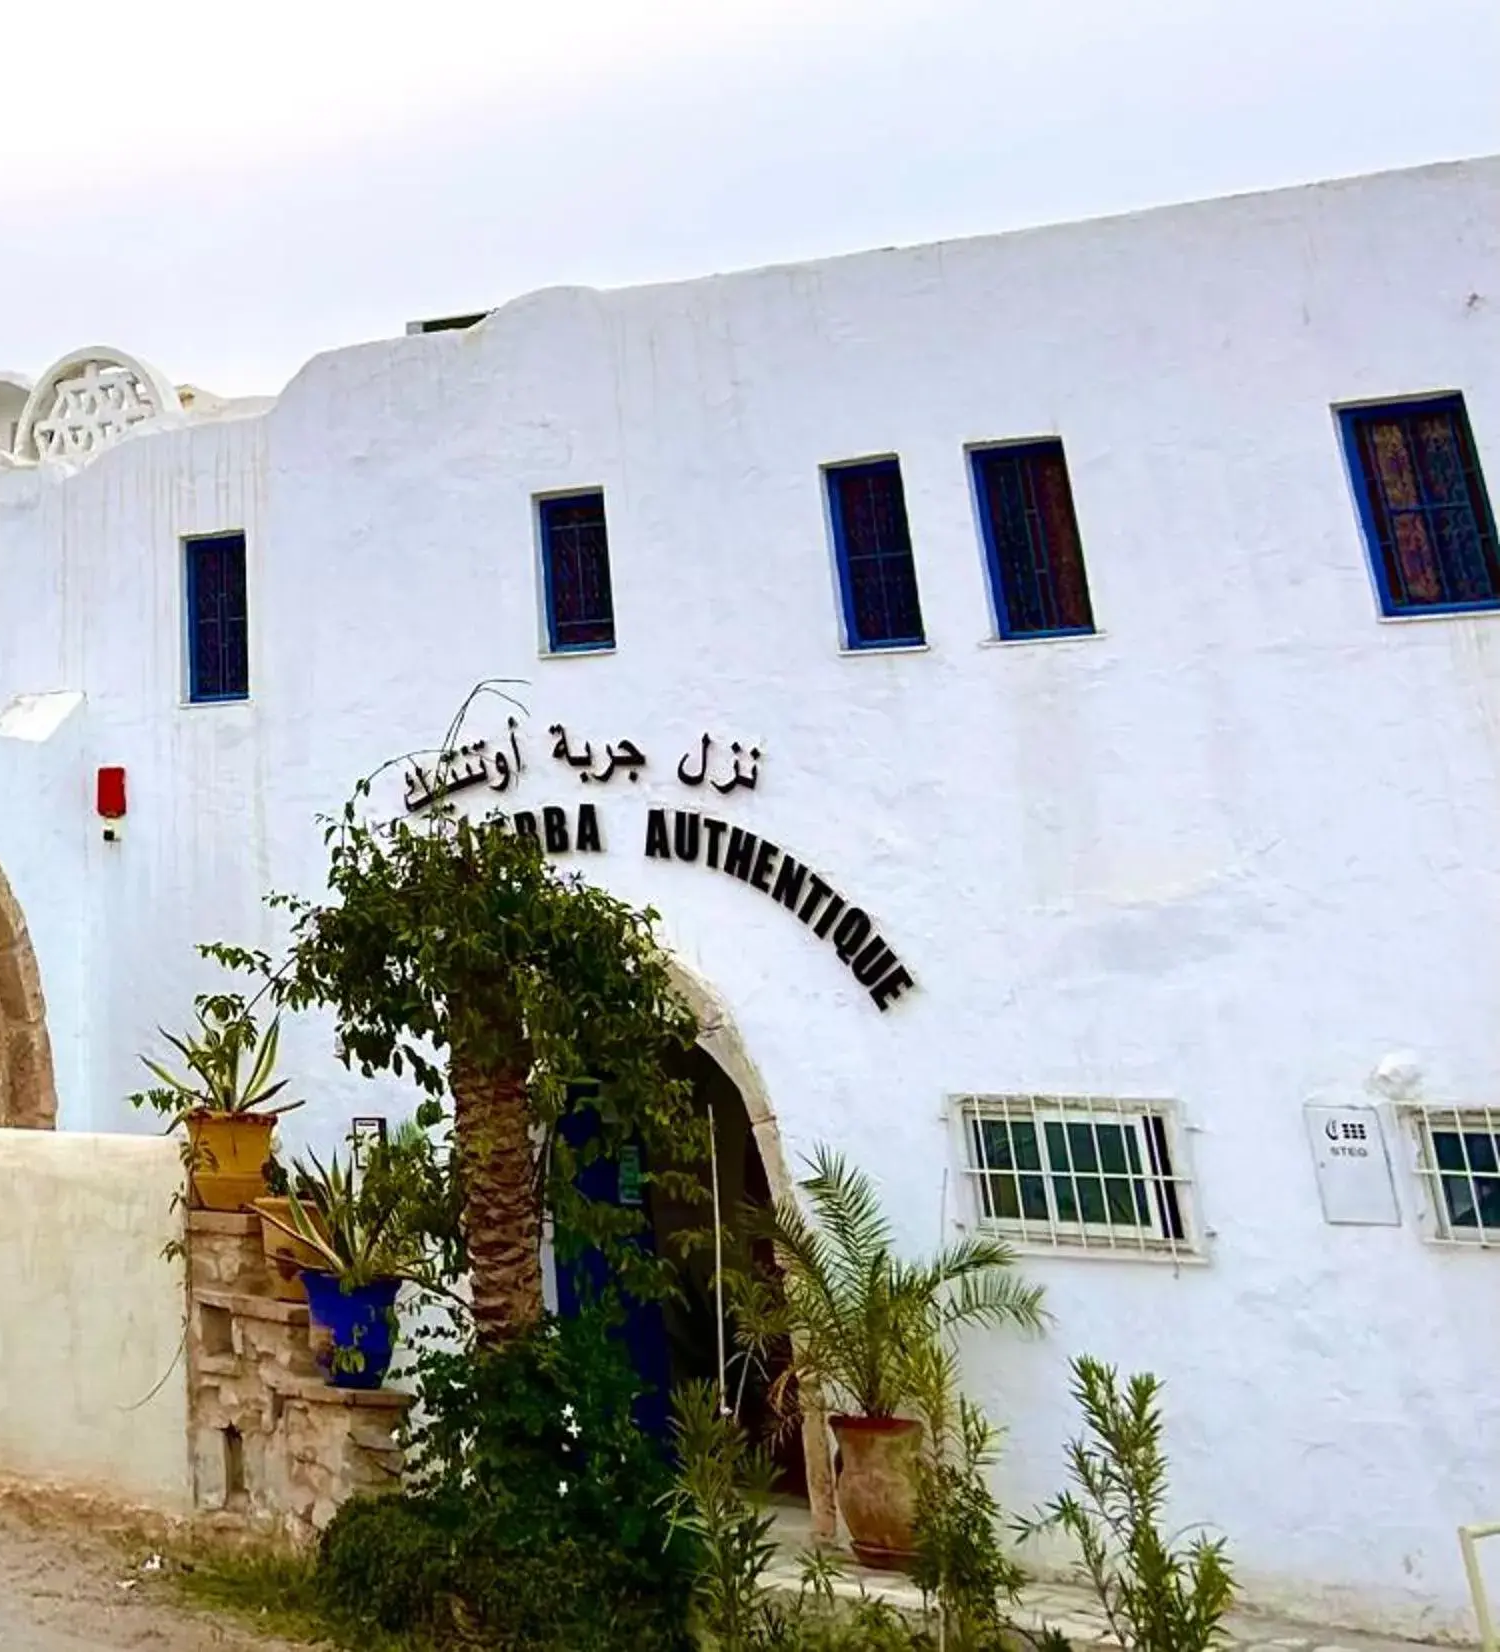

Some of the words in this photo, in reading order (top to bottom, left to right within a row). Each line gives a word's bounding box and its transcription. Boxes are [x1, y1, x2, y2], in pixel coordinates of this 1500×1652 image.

[548, 722, 646, 783] جربة
[678, 731, 763, 794] نزل
[645, 809, 915, 1013] AUTHENTIQUE
